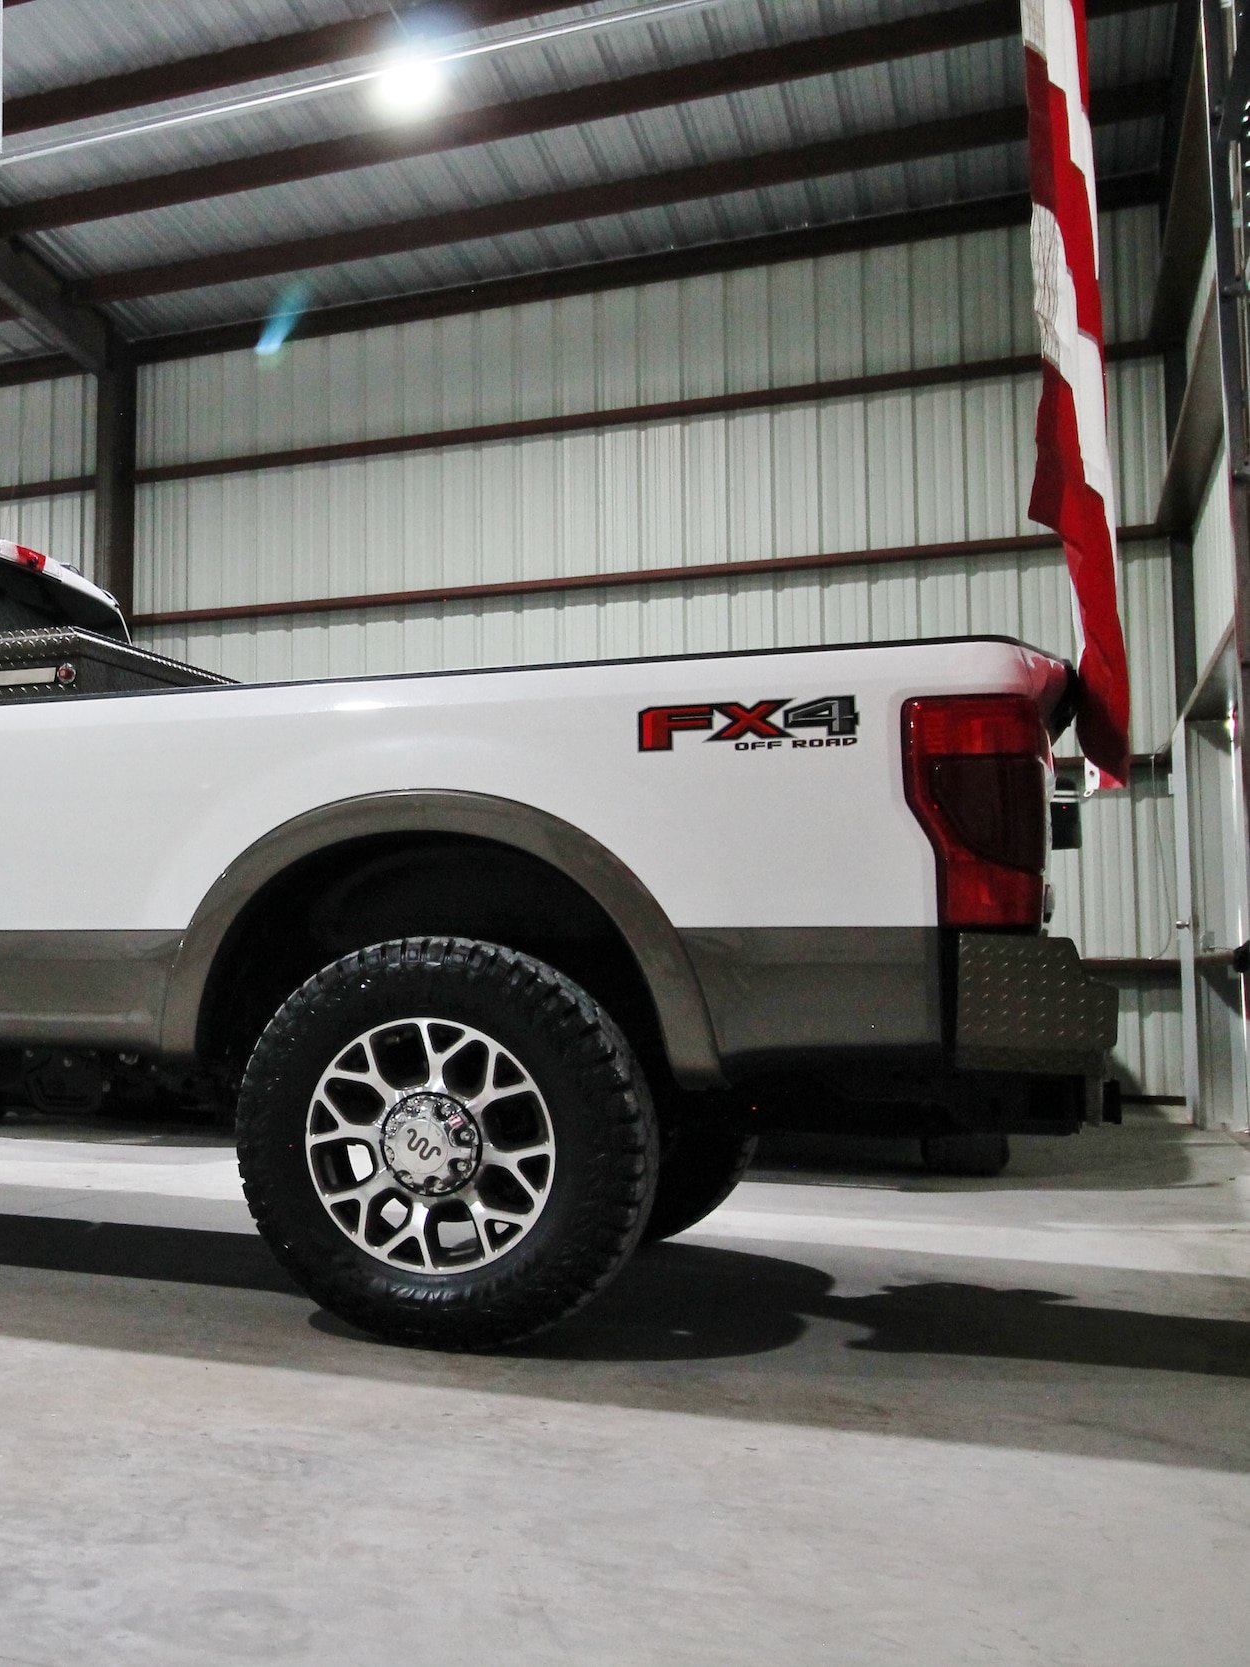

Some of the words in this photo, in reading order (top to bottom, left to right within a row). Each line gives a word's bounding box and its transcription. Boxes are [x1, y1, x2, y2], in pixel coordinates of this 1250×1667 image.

[638, 695, 859, 752] FX4
[734, 741, 782, 751] OFF
[793, 737, 858, 749] ROAD
